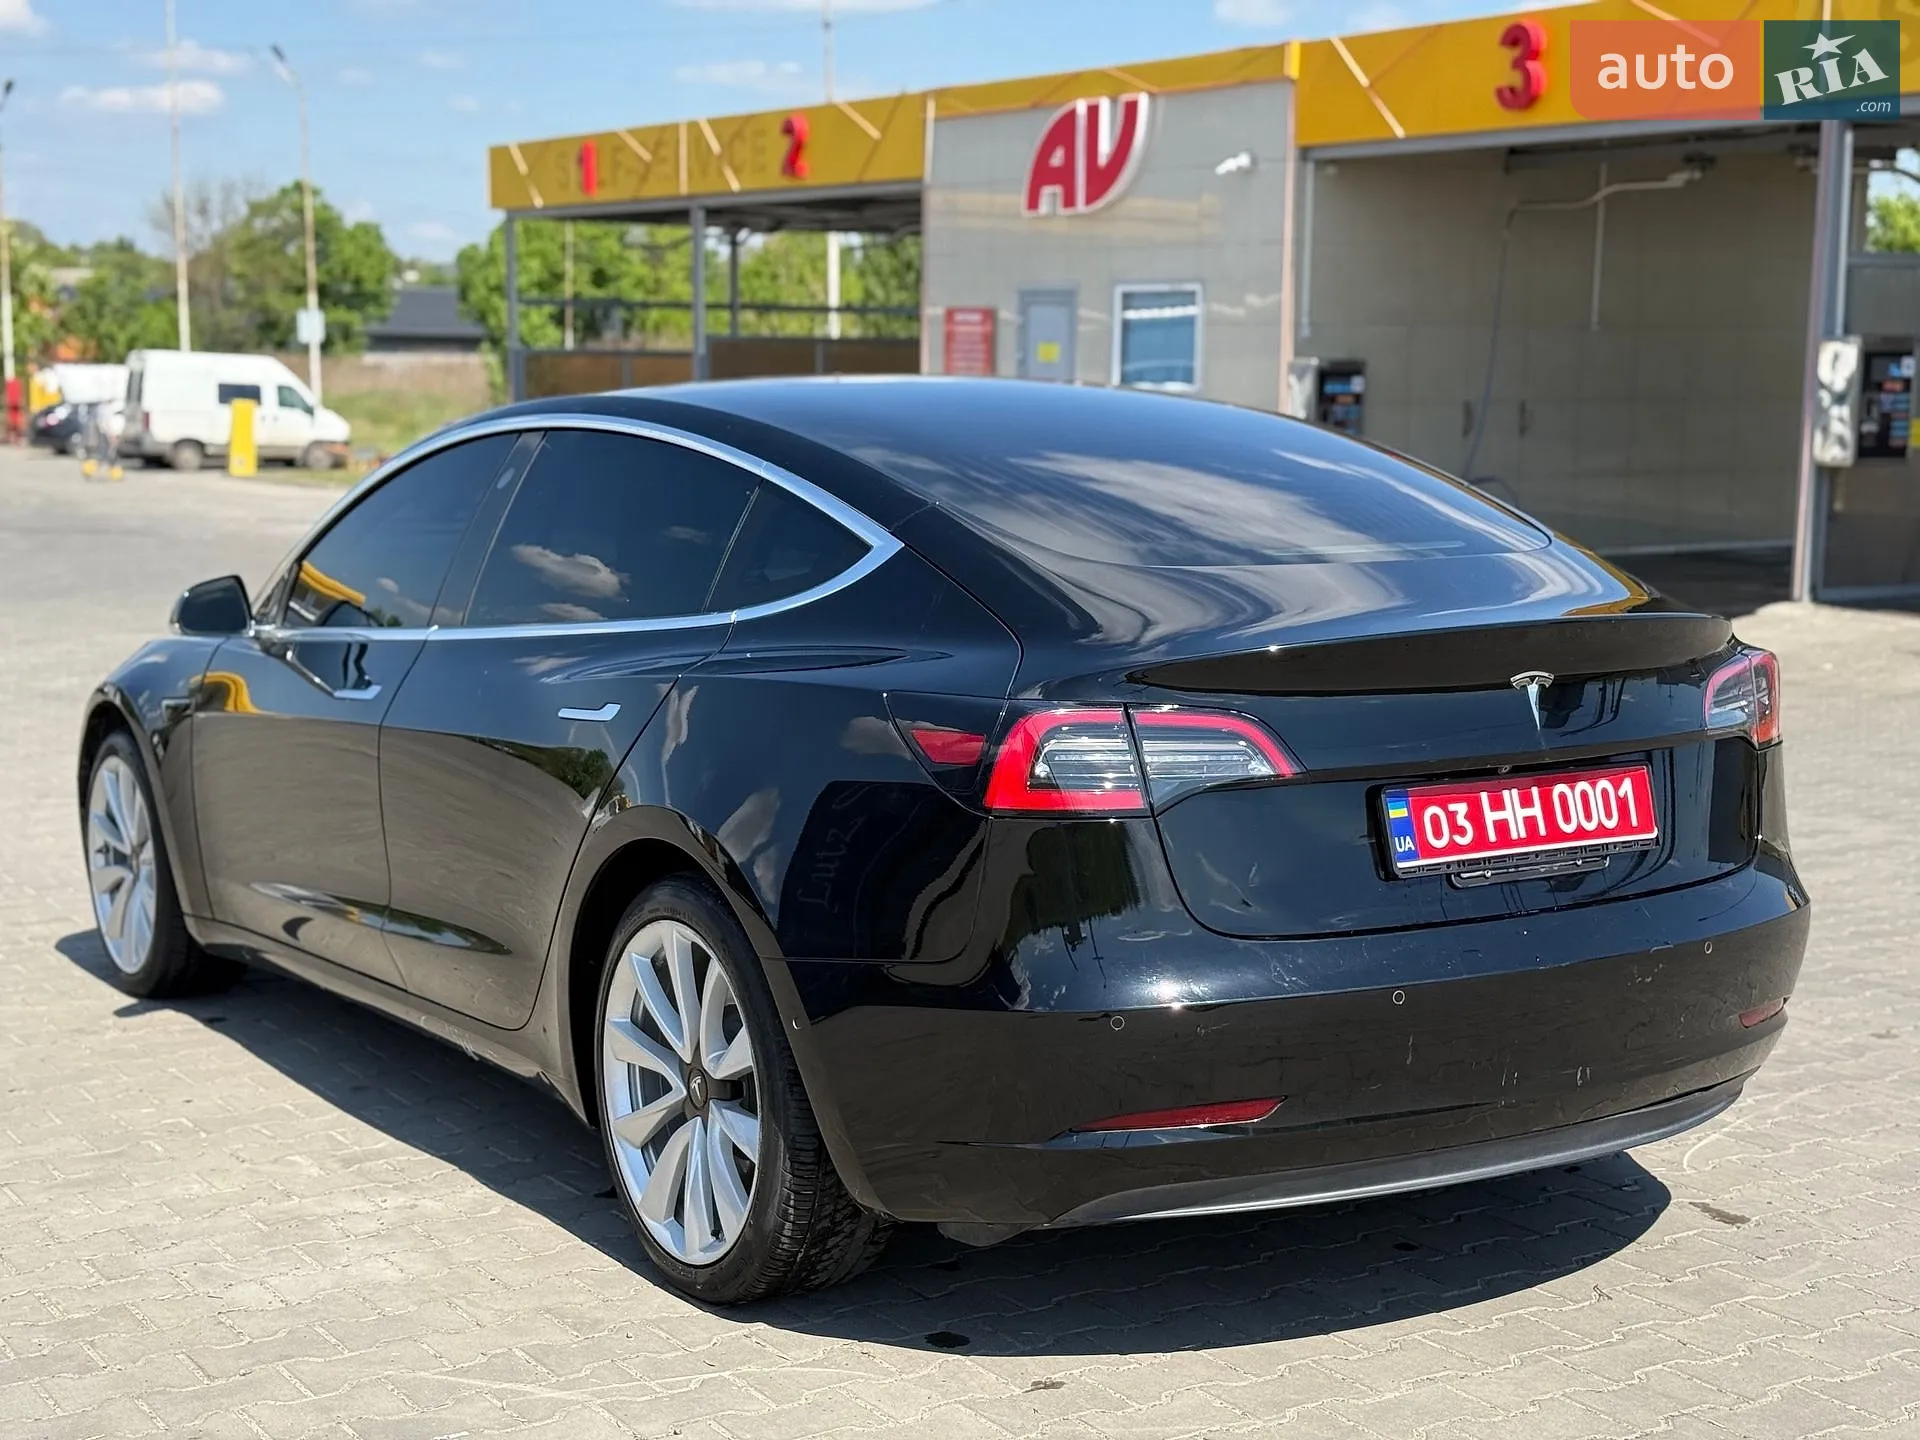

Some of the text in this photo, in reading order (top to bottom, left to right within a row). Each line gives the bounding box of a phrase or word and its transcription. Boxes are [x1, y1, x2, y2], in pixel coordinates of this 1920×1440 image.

[1495, 20, 1547, 111] 3
[577, 139, 597, 197] 1
[781, 114, 809, 179] 2
[1024, 93, 1148, 216] AV
[1395, 836, 1415, 852] UA
[1423, 777, 1639, 849] 03 HH 0001
